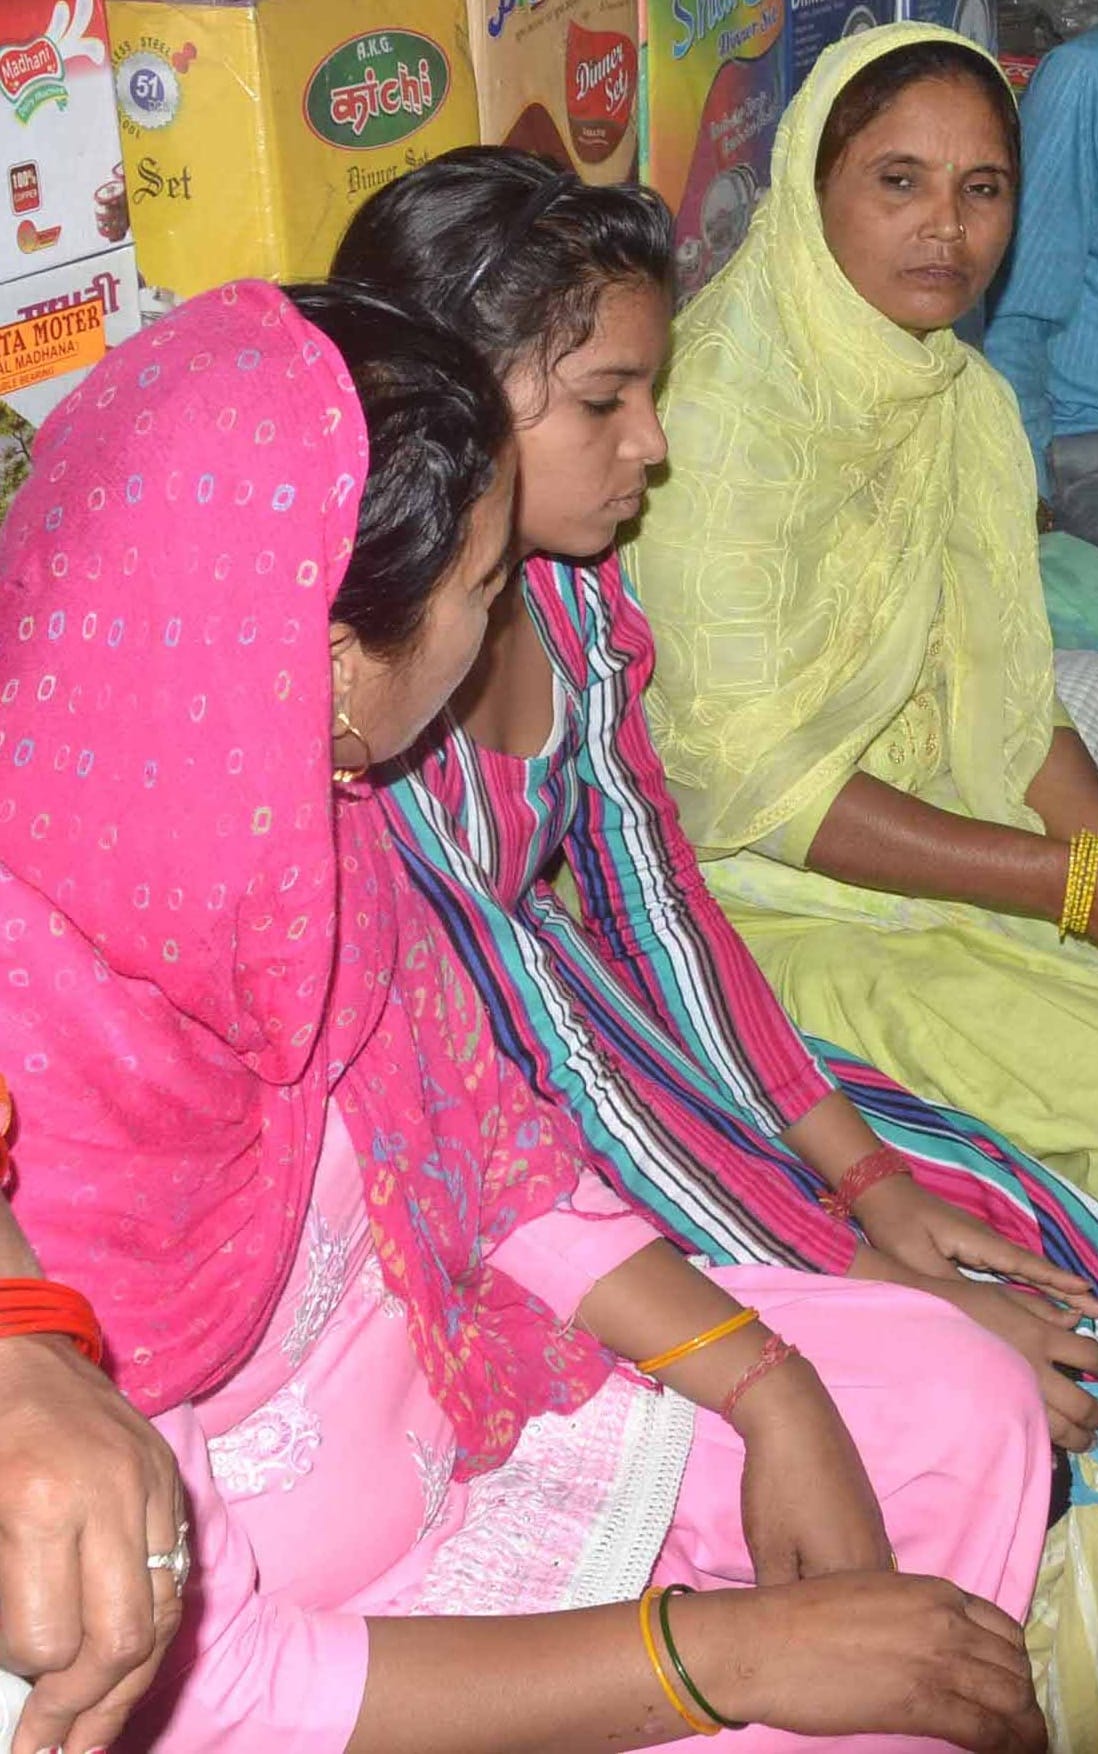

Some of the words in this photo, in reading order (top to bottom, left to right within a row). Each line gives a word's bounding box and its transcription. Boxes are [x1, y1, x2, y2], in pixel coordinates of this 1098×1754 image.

[1, 44, 51, 82] Madhani
[576, 43, 624, 101] Dinner
[135, 74, 159, 99] 51
[133, 156, 193, 205] Set
[347, 164, 398, 194] Dinner
